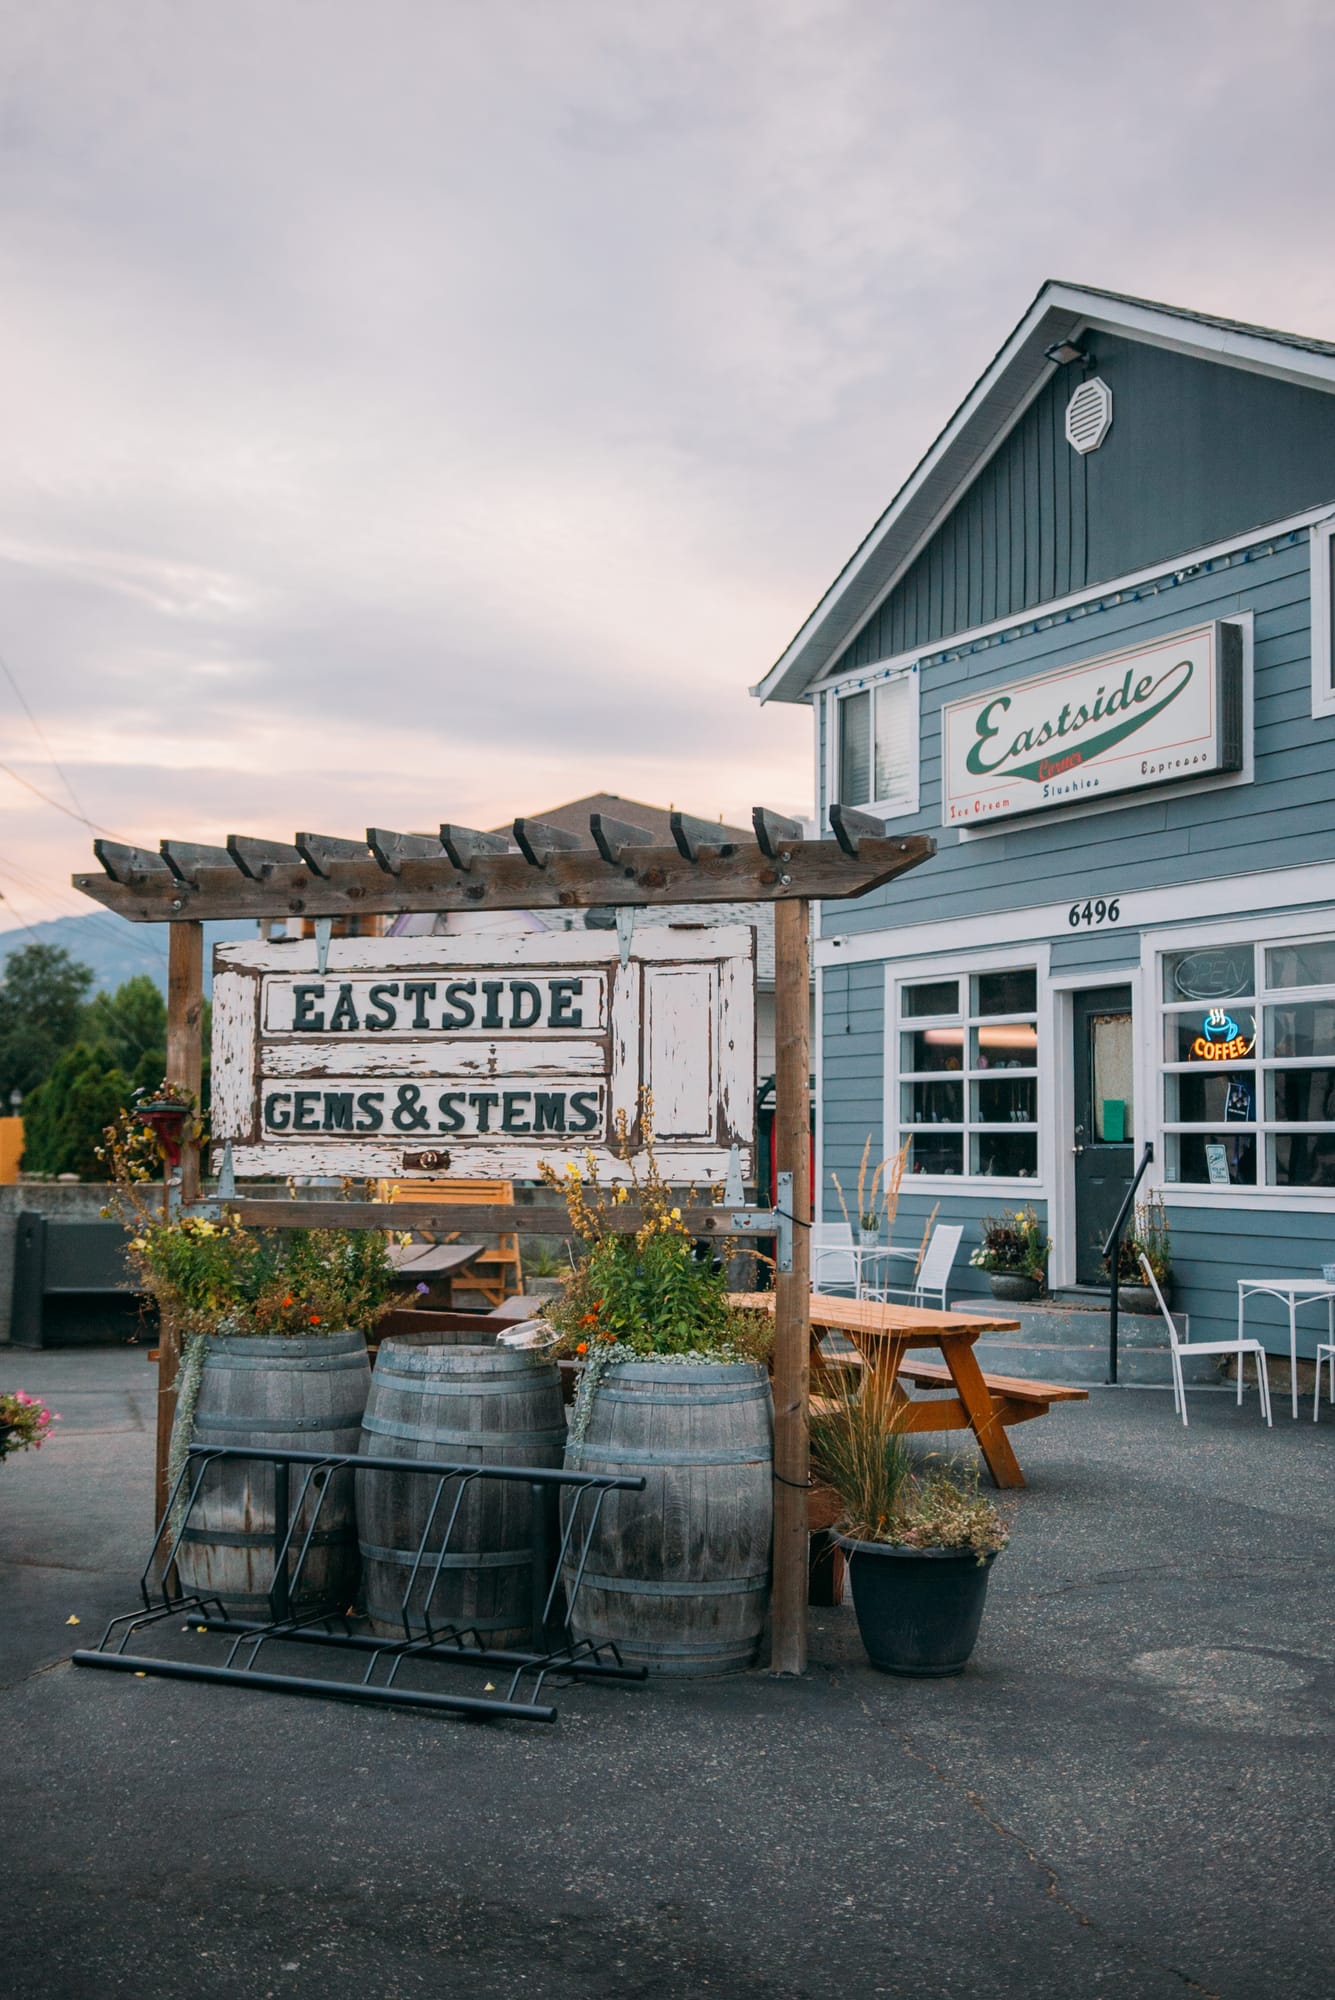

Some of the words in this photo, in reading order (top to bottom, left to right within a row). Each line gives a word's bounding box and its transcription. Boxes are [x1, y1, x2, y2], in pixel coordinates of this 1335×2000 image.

[966, 660, 1194, 776] Eastside
[1141, 753, 1208, 775] Espresso
[1043, 778, 1099, 798] Slushies
[950, 805, 969, 818] Ice
[974, 799, 1010, 813] Cream
[1068, 898, 1120, 927] 6496
[1179, 959, 1246, 985] OPEN
[292, 979, 583, 1031] EASTSIDE
[1194, 1036, 1246, 1060] COFFEE
[264, 1090, 385, 1132] GEMS
[391, 1084, 430, 1132] &
[438, 1091, 600, 1132] STEMS
